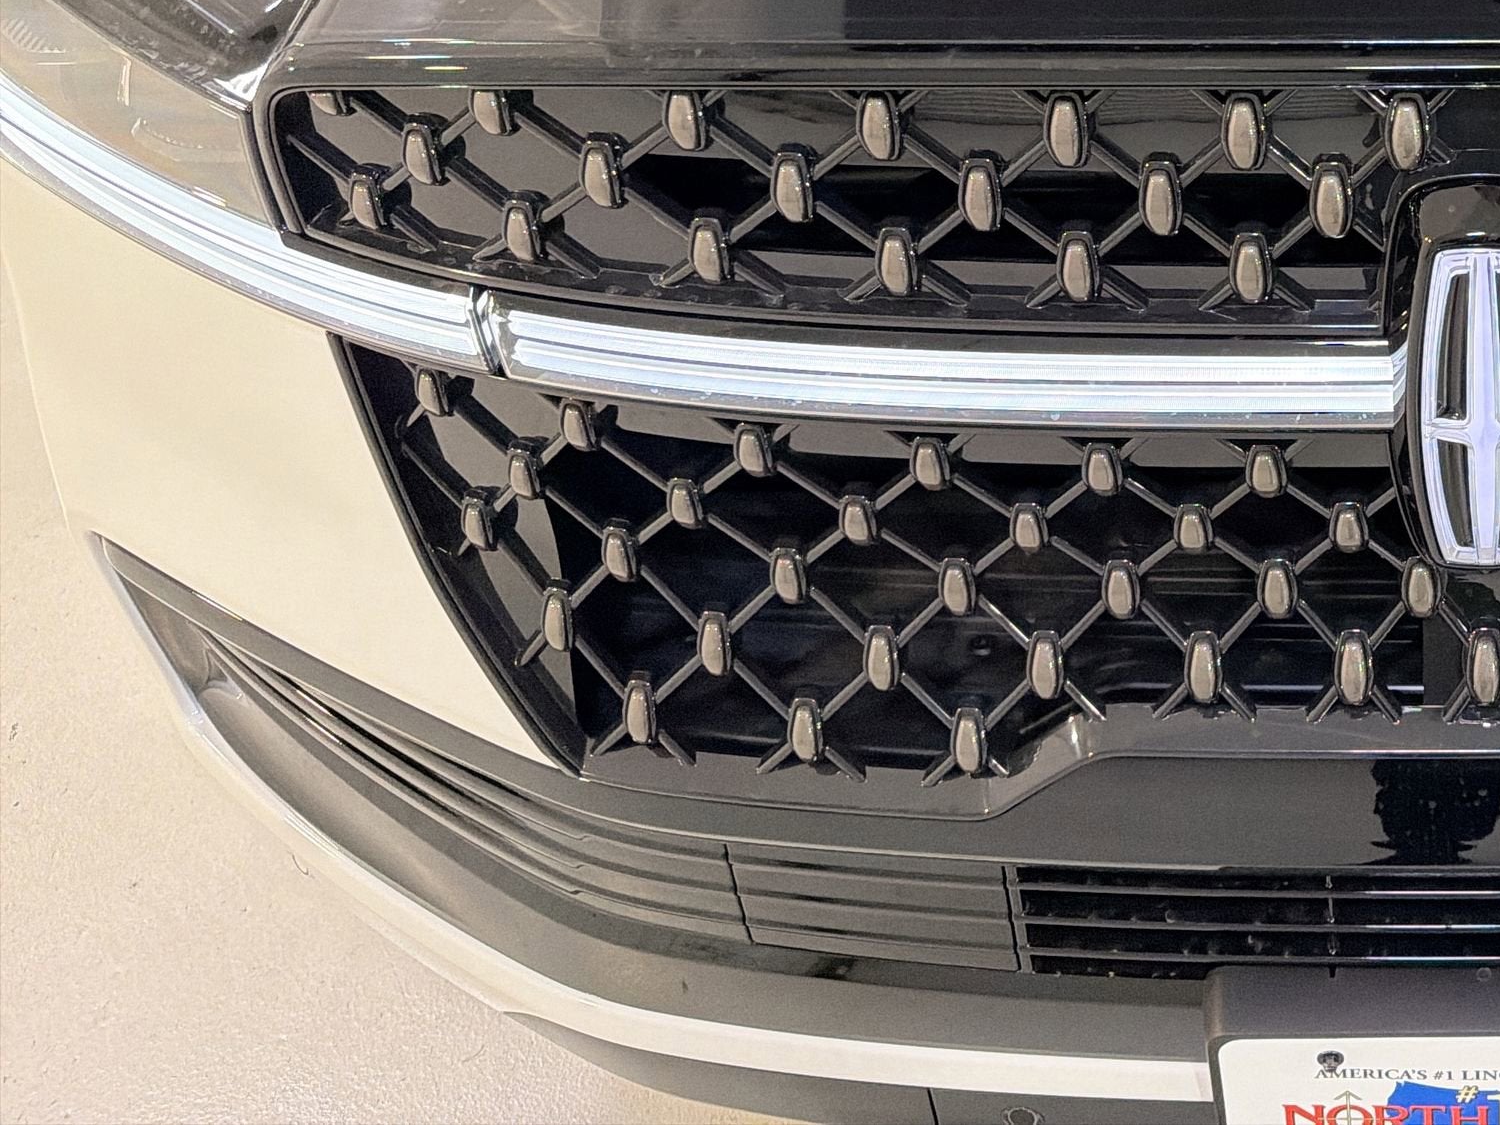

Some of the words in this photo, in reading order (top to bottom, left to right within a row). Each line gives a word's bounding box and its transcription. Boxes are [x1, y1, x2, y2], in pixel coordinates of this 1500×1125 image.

[1314, 1068, 1428, 1080] AMERICA'S
[1433, 1070, 1455, 1081] #1
[1281, 1103, 1490, 1125] NORTH
